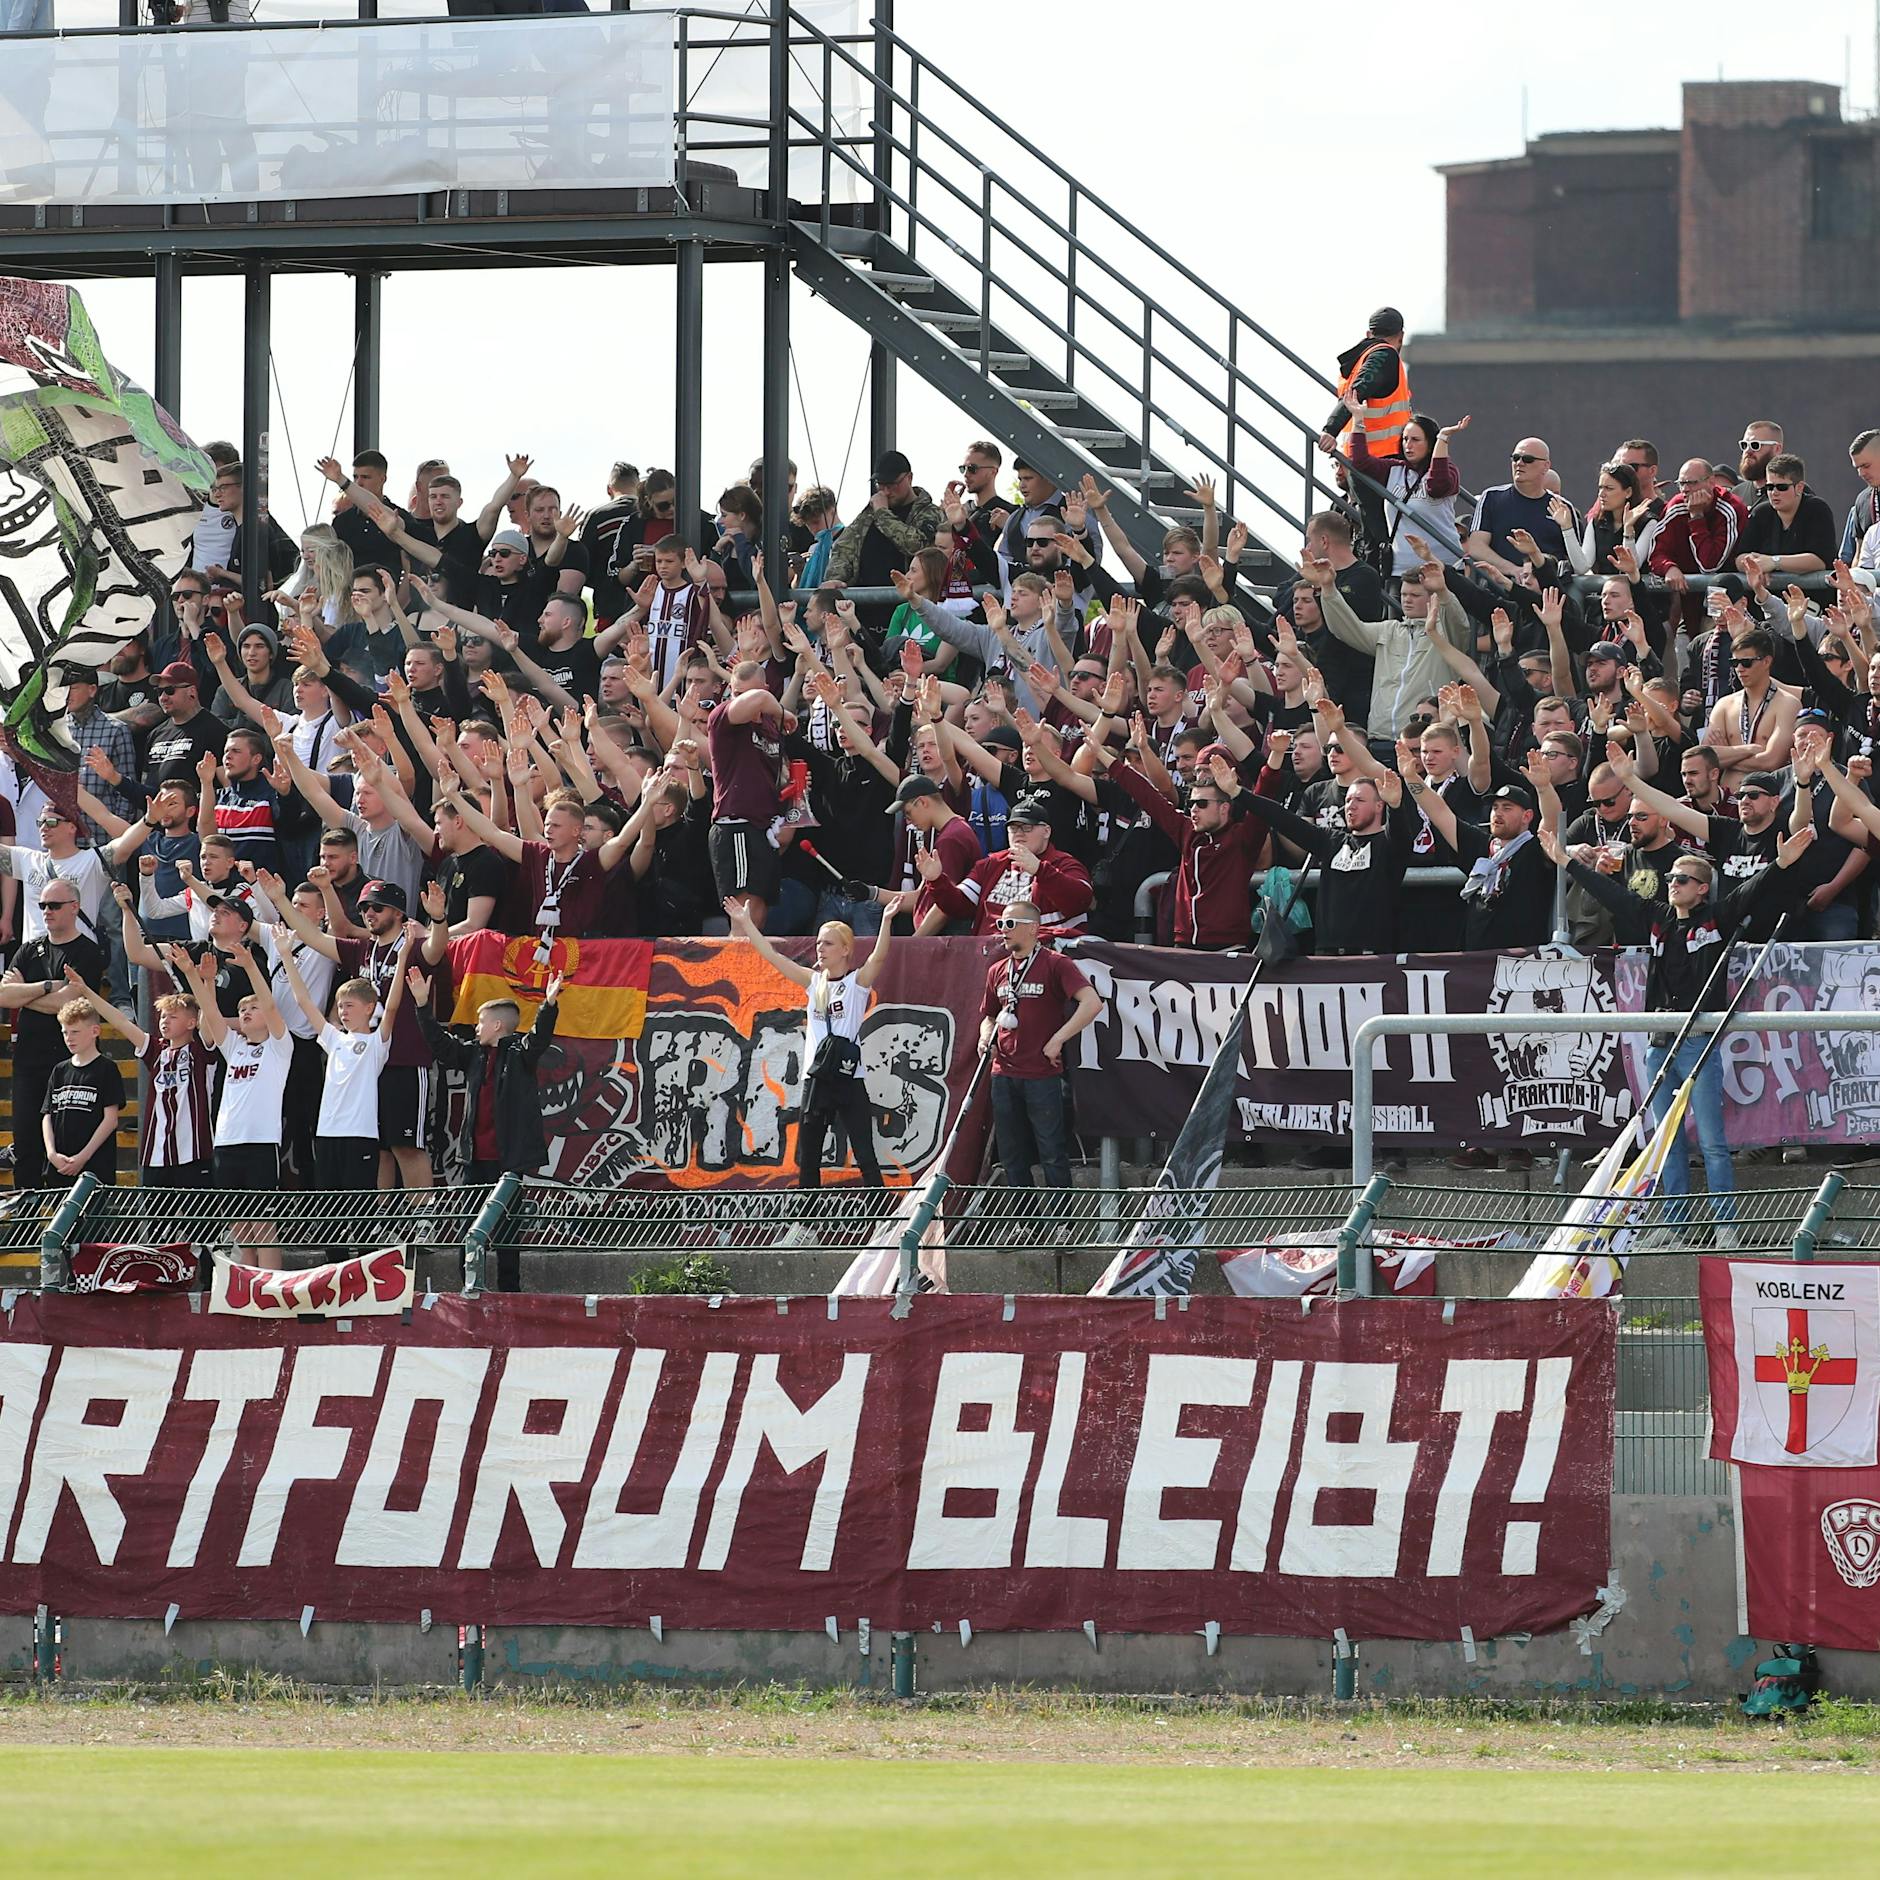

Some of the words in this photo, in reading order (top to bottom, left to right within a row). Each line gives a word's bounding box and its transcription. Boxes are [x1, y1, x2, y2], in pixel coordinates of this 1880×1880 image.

[1832, 1080, 1880, 1113] FRAKT
[1236, 1097, 1334, 1134] BERLINER
[1846, 1112, 1880, 1136] Pief
[110, 1254, 131, 1272] NORD
[225, 1250, 406, 1311] ULTRAS
[1756, 1282, 1845, 1300] KOBLENZ
[907, 1351, 1573, 1578] BLEIBT!
